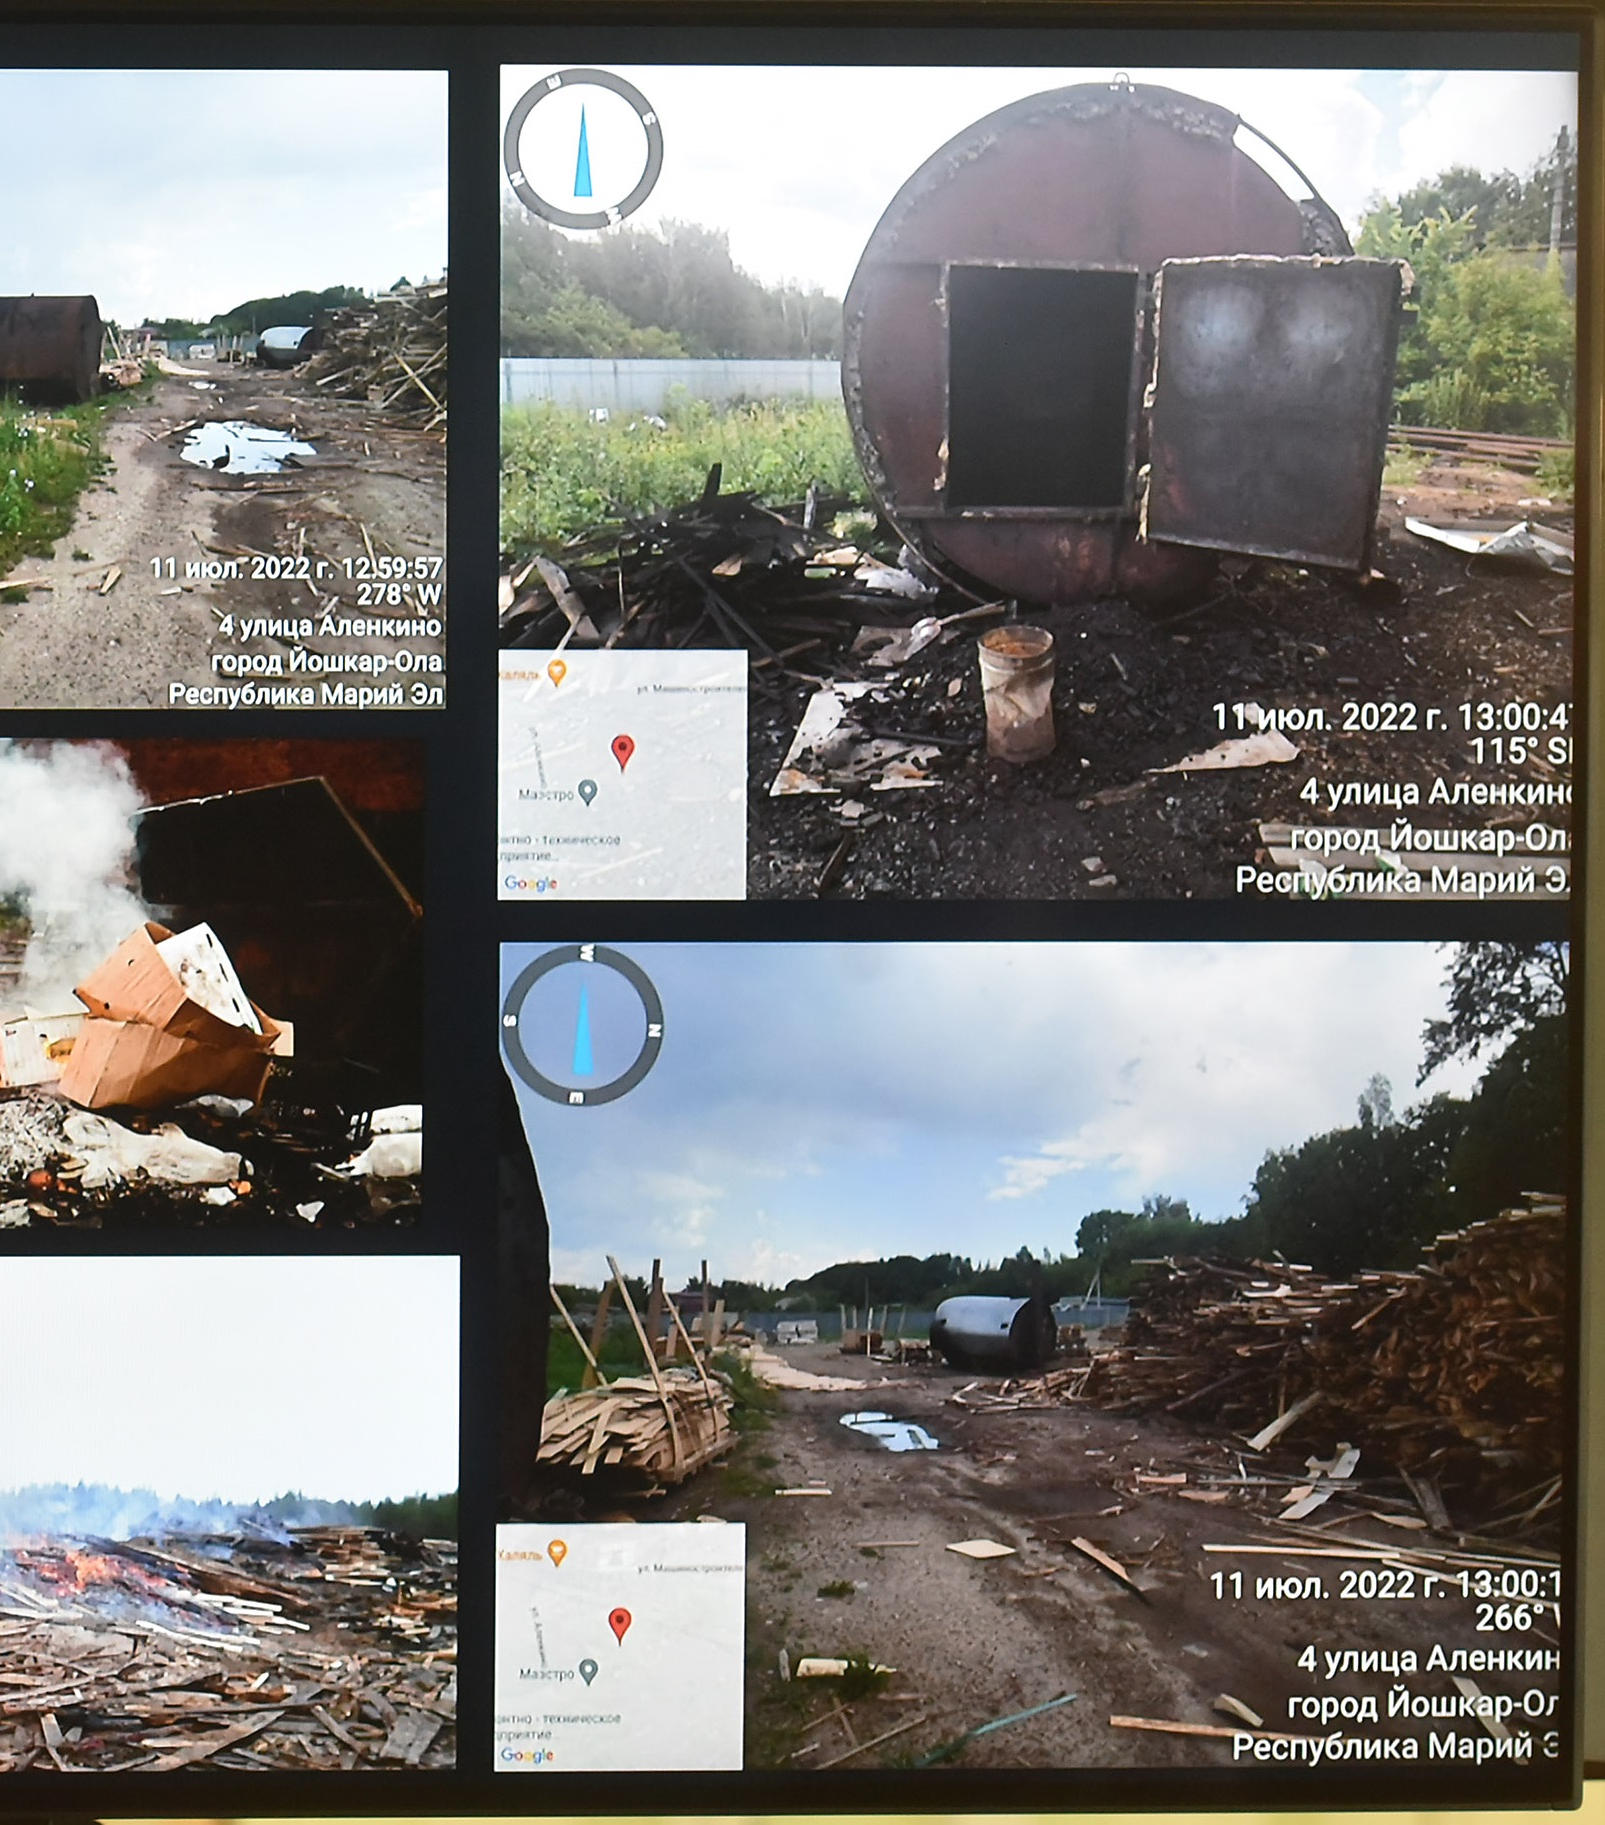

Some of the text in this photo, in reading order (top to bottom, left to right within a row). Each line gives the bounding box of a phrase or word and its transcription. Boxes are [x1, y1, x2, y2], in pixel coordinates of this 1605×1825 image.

[149, 557, 443, 580] 11 июл. 2022 г. 12:59:57
[356, 582, 443, 606] 278° W
[218, 615, 442, 642] 4 улица Аленкино
[211, 646, 443, 677] город Йошкар-Ола
[169, 682, 443, 710] Республика Марий Эл
[1212, 703, 1573, 731] 11 июл. 2022 г. 13:00:4
[1471, 737, 1573, 765] 115° S
[1299, 777, 1319, 805] 4
[1327, 782, 1420, 811] улица
[1291, 817, 1571, 857] город Йошкар-Ол
[504, 875, 558, 893] Google
[1236, 865, 1571, 900] Республика Марий Э
[1210, 1570, 1561, 1600] 11 июл. 2022 г. 13:00:1
[1475, 1603, 1545, 1631] 266°
[1297, 1645, 1560, 1680] 4 улица Аленкин
[1288, 1696, 1378, 1725] город
[501, 1747, 554, 1764] Google
[1233, 1732, 1419, 1767] Республика
[1428, 1732, 1533, 1765] Марий
